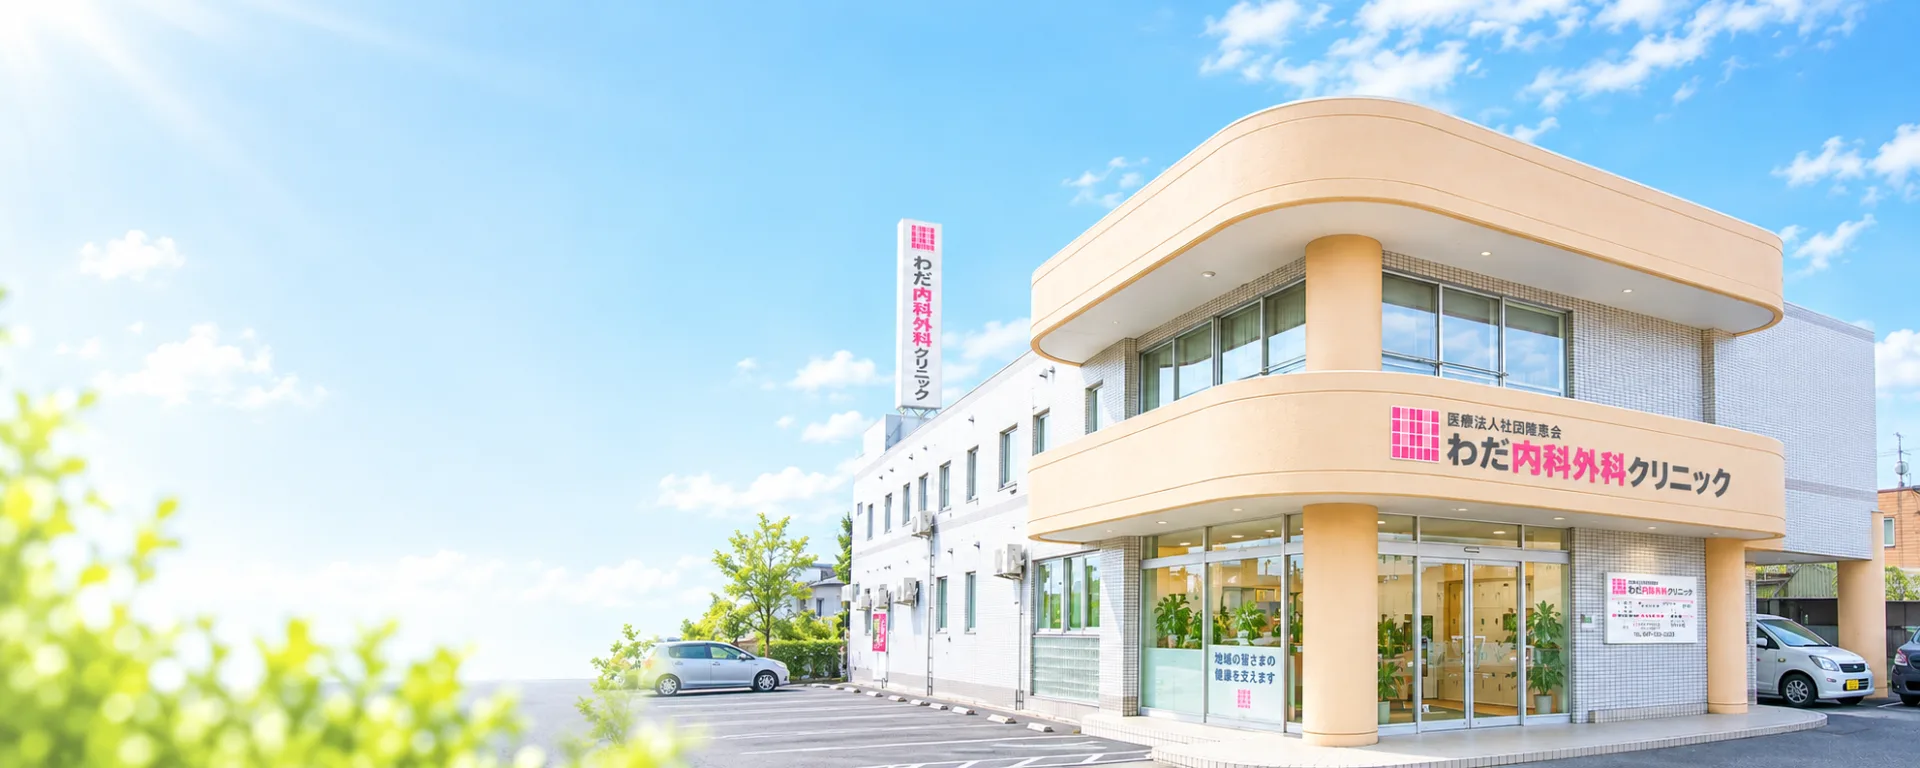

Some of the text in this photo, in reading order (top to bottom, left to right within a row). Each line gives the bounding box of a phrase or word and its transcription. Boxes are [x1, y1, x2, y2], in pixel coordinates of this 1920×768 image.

[912, 255, 933, 401] わだ内科外科クリニック
[1446, 433, 1732, 498] わだ内科外科クリニック
[1214, 652, 1276, 667] 地域の皆さまの
[1214, 668, 1275, 685] 健康を支えます
